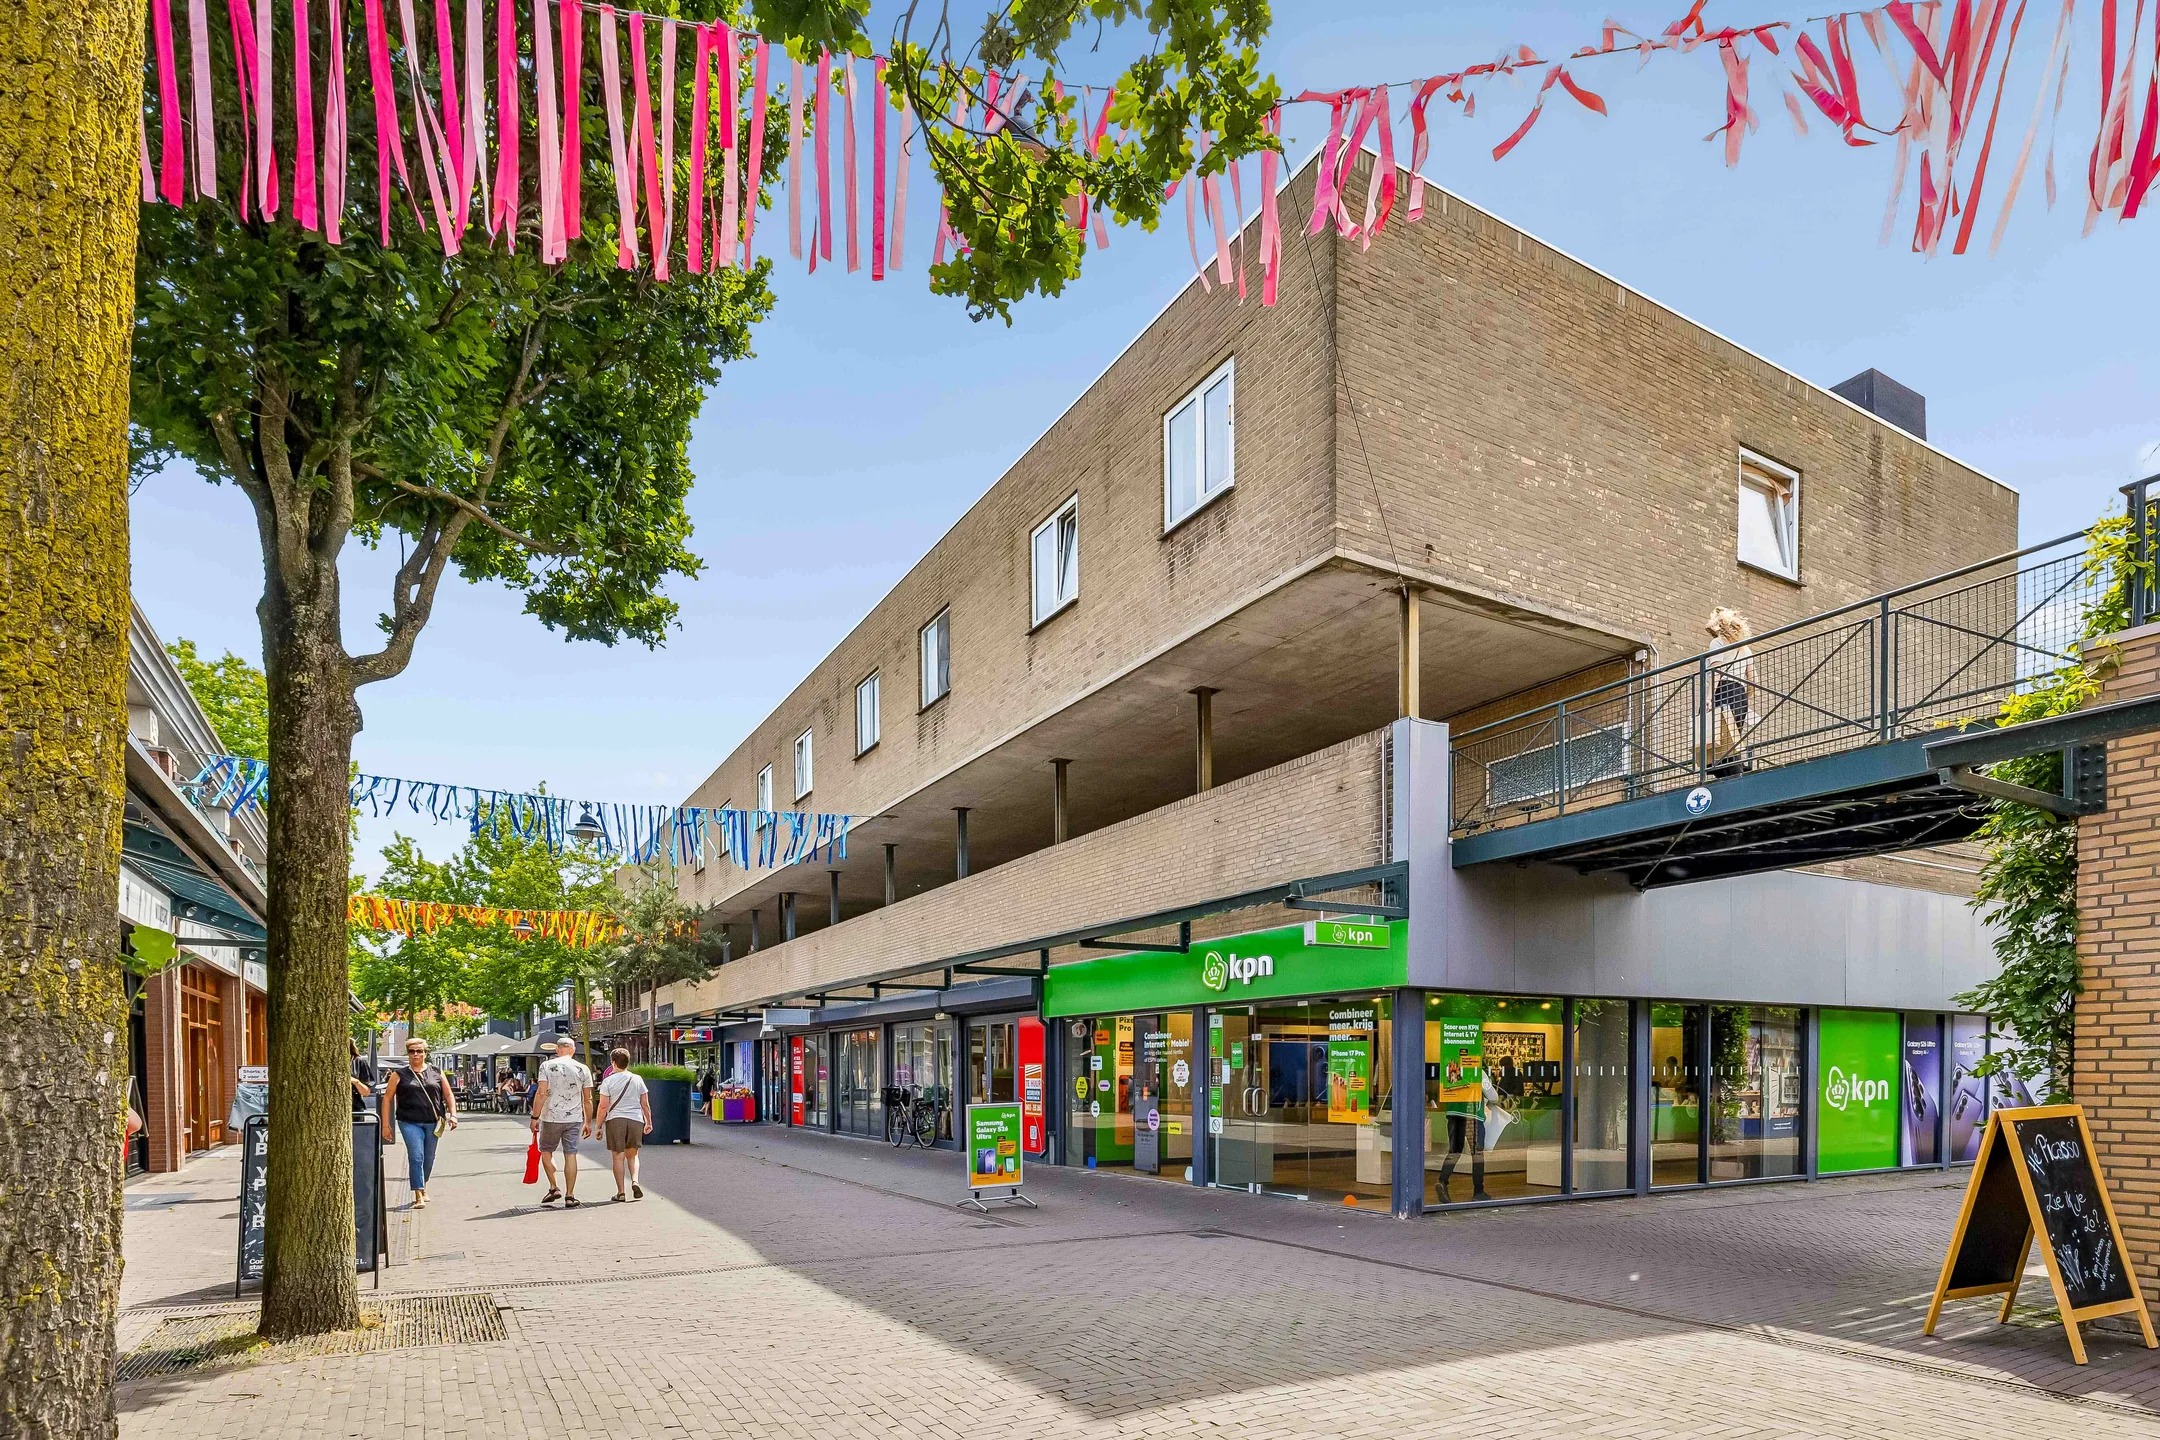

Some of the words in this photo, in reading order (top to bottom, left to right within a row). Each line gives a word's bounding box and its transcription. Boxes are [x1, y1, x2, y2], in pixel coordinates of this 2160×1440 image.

[1349, 928, 1373, 944] kpn
[1230, 954, 1273, 985] kpn
[1329, 1008, 1374, 1020] Combineer
[1119, 1024, 1132, 1032] Pro
[1353, 1020, 1374, 1031] krijg
[1144, 1031, 1172, 1040] Combineer
[1329, 1033, 1352, 1041] meer.
[1144, 1040, 1165, 1048] Internet
[1171, 1039, 1190, 1048] Mobiel
[1852, 1074, 1889, 1107] kpn
[2035, 1133, 2080, 1164] Picasso
